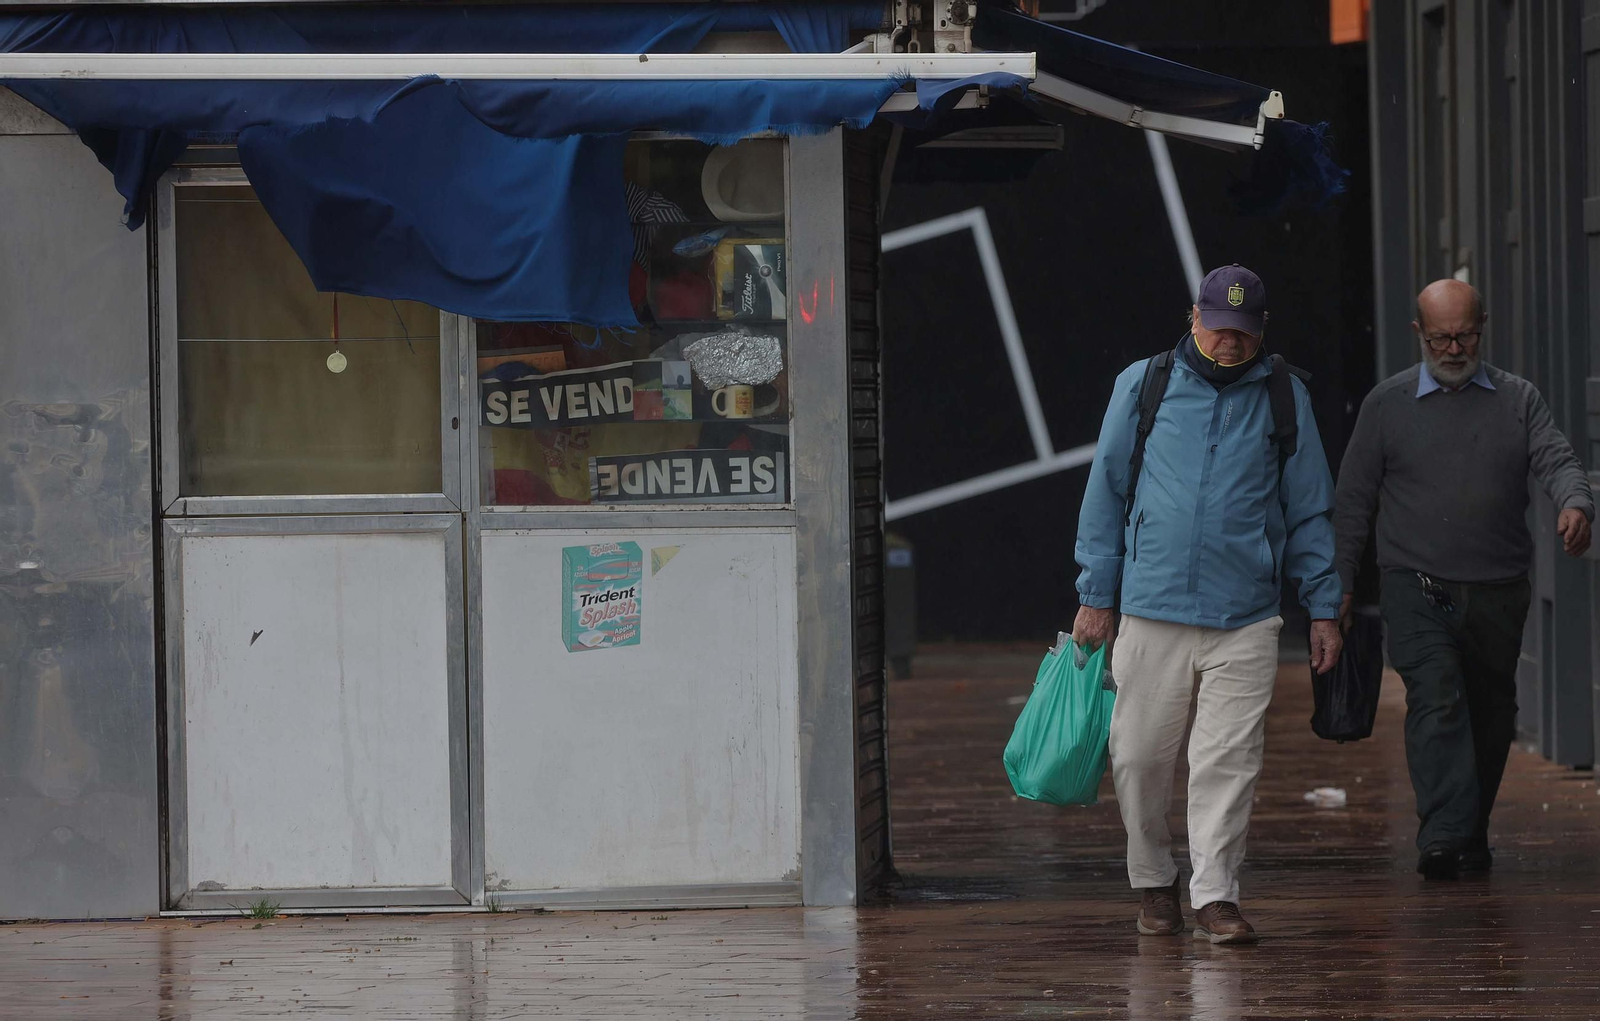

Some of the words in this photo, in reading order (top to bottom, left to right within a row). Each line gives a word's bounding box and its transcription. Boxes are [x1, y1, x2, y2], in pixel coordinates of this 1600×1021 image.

[741, 272, 754, 315] Titleist
[486, 389, 531, 425] SE
[597, 457, 720, 496] VENDE
[729, 455, 775, 493] SE
[590, 543, 619, 556] Splash
[580, 586, 635, 608] Trident
[580, 599, 637, 629] Splash
[612, 629, 636, 643] Apricot
[614, 624, 633, 635] Apple
